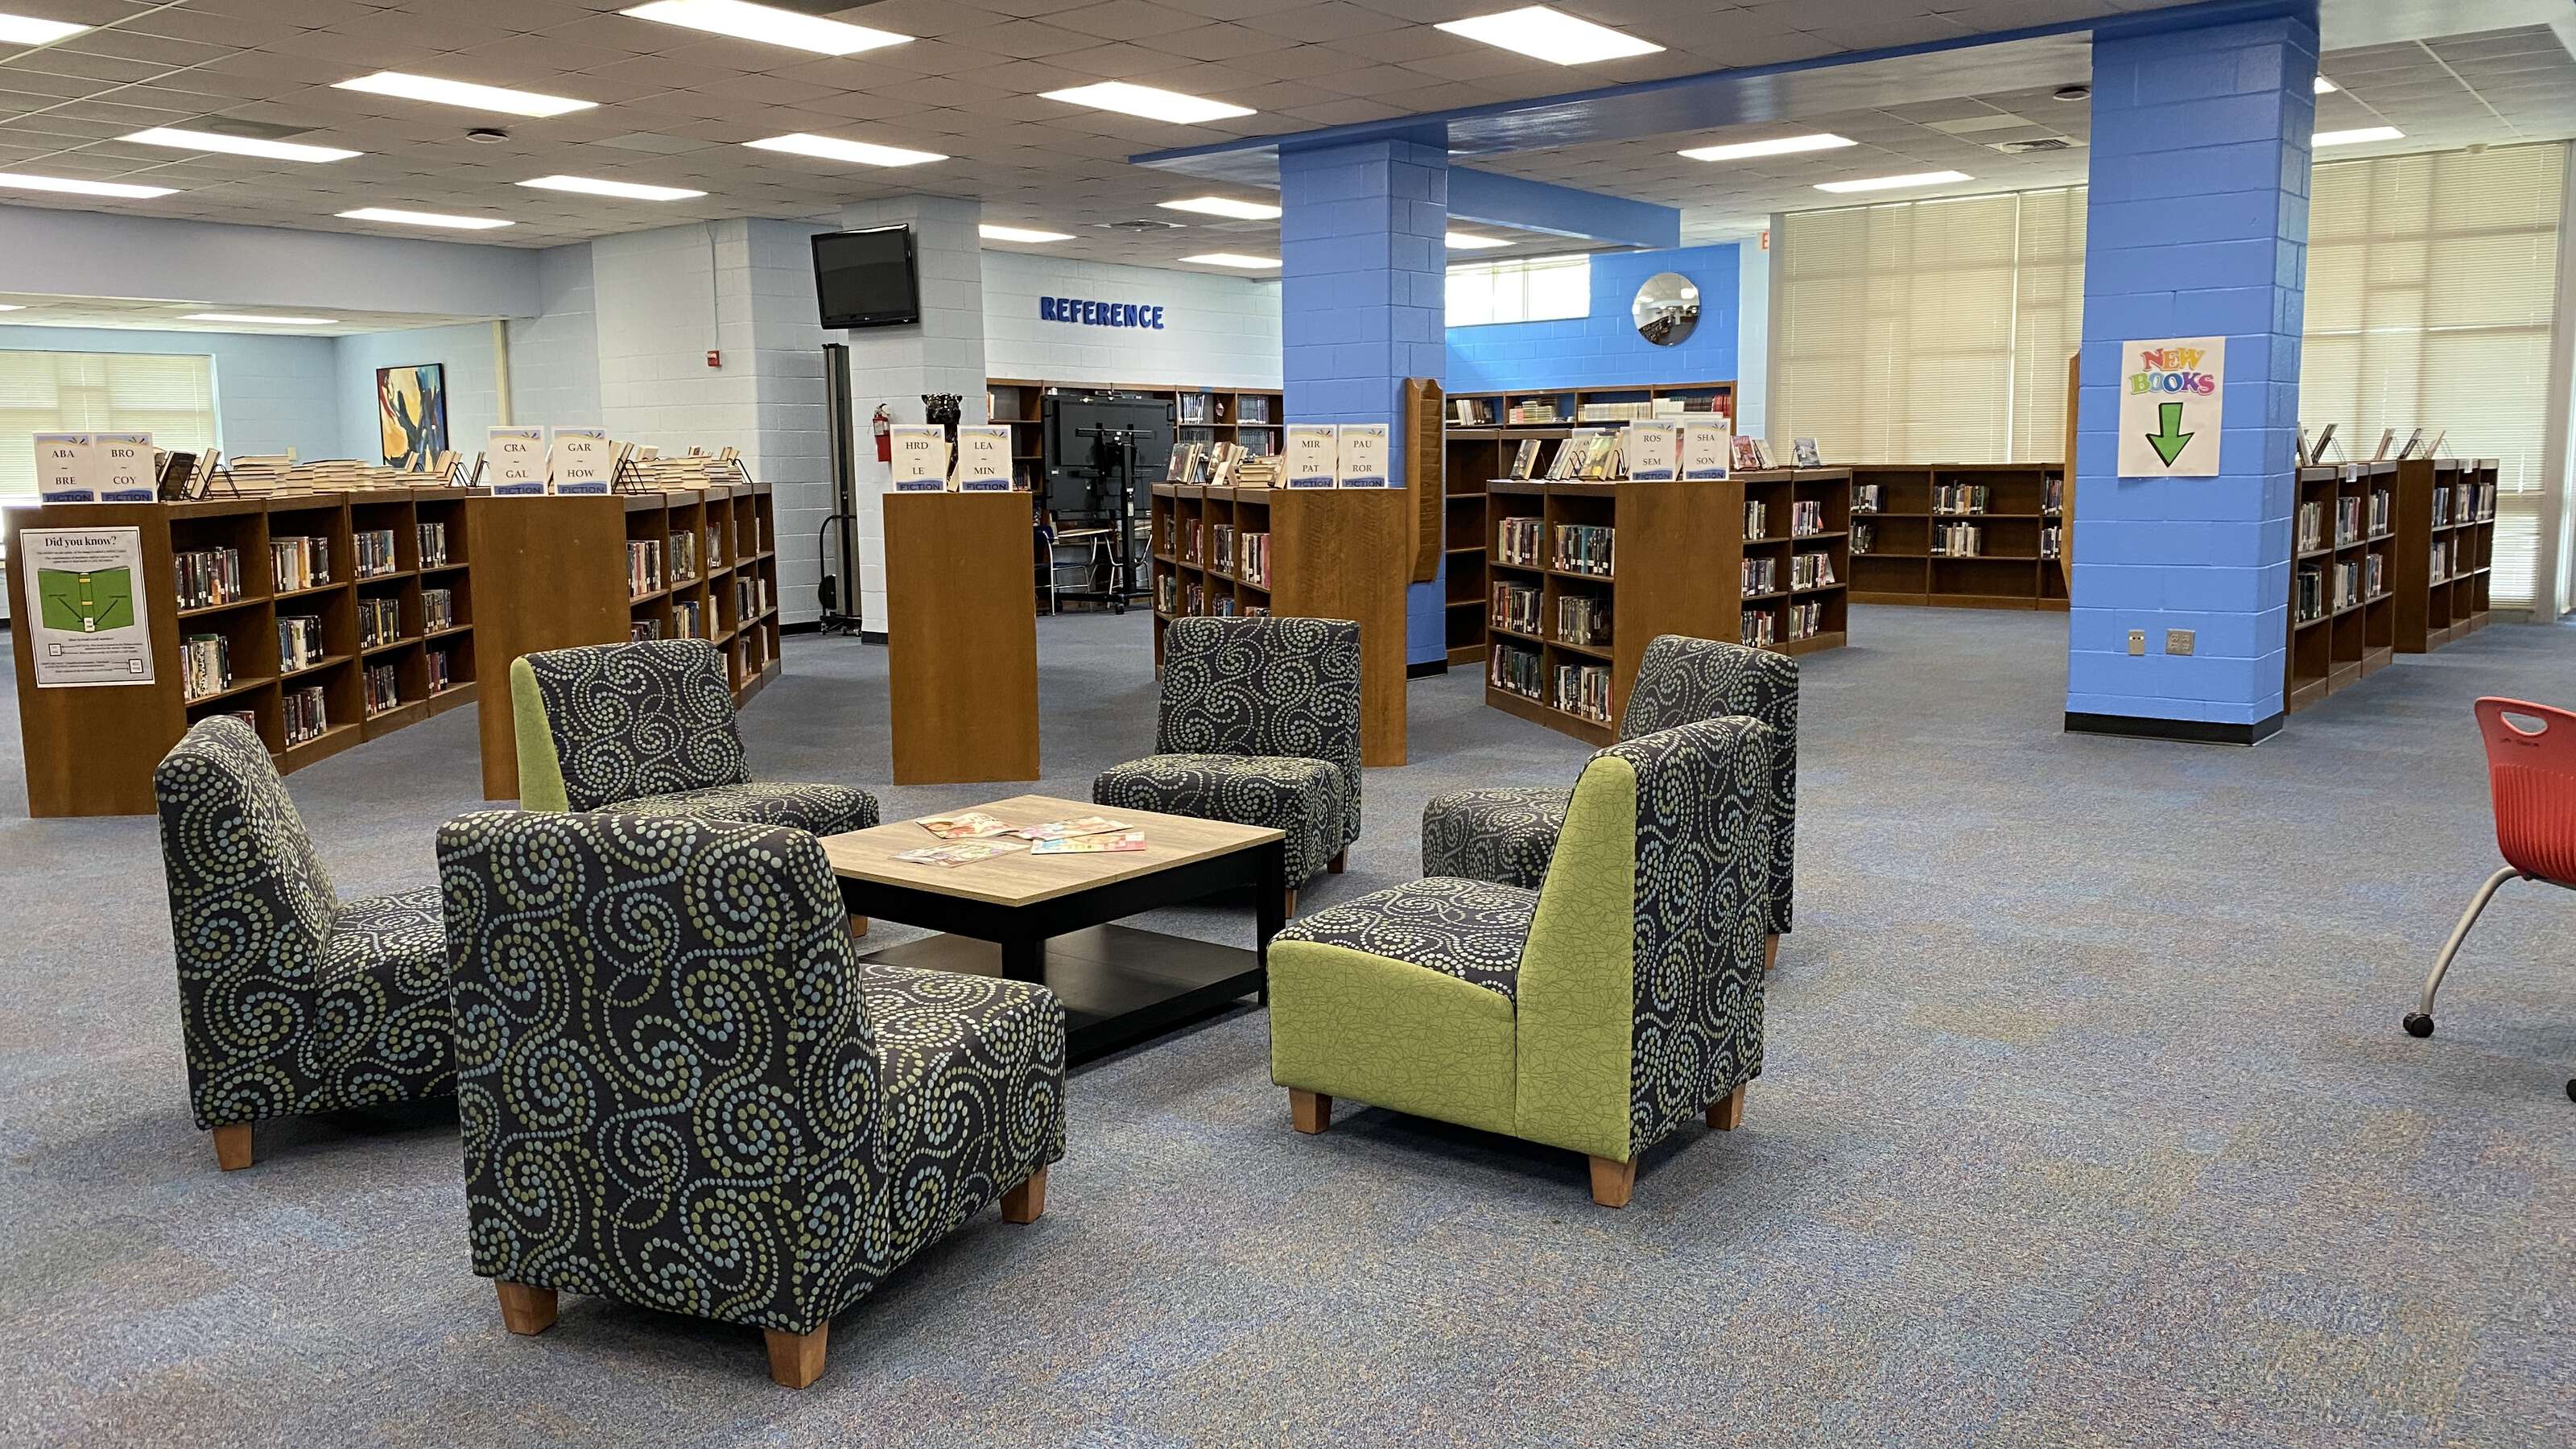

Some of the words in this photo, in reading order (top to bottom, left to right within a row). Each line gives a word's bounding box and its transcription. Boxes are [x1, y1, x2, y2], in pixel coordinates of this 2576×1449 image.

[1040, 296, 1164, 329] REFERENCE
[2140, 347, 2204, 371] NEW
[2129, 372, 2215, 396] BOOKS
[504, 444, 526, 452] CRA
[568, 444, 592, 452] GAR
[906, 442, 929, 450] HRD
[974, 442, 993, 450] LEA
[52, 450, 74, 458] ABA
[111, 449, 134, 457] BRO
[913, 467, 925, 475] LE
[974, 467, 995, 475] MIN
[1302, 464, 1319, 473] PAT
[506, 470, 528, 478] GAL
[568, 469, 594, 477] HOW
[56, 477, 76, 485] BRE
[114, 477, 136, 485] COY
[45, 538, 63, 547] Did
[64, 539, 83, 547] you
[85, 536, 117, 546] know?
